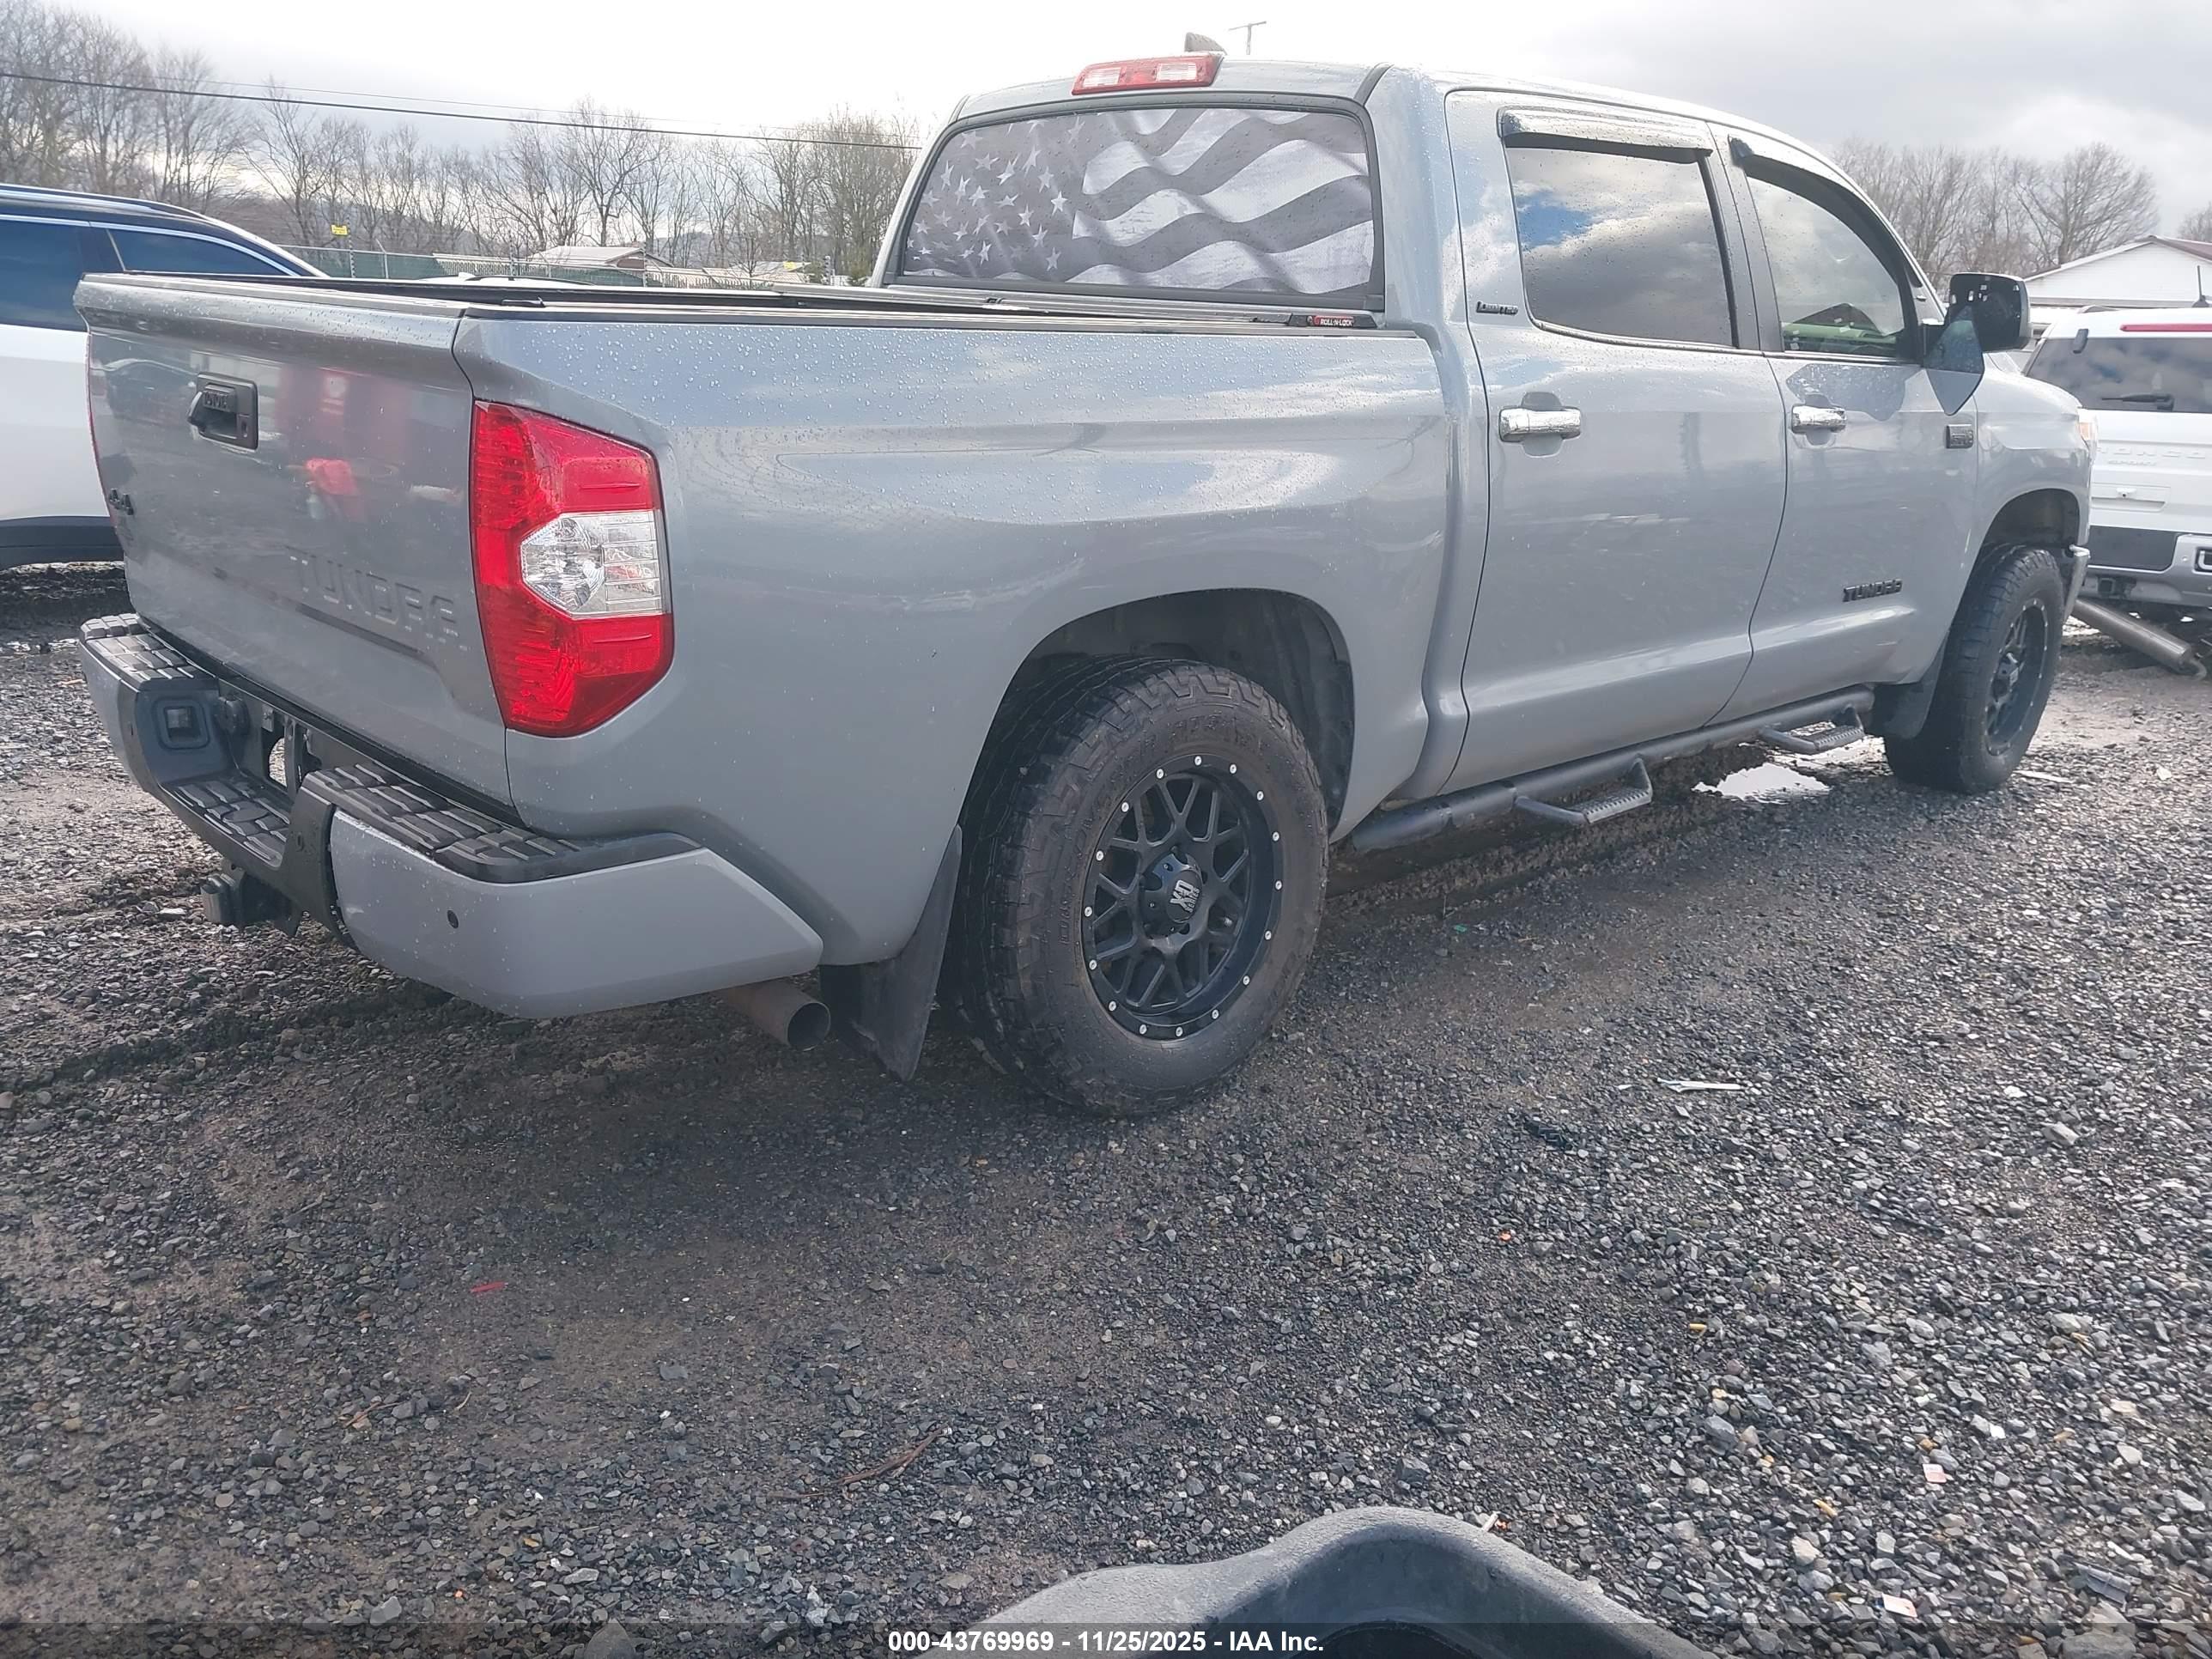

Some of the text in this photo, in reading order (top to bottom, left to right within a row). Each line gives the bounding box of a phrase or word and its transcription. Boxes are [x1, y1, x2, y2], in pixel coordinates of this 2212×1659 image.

[1320, 318, 1354, 327] ROLL-N-LOCK
[284, 544, 469, 652] TUNDRA
[1842, 578, 1903, 603] TUNDRA
[1170, 879, 1194, 910] XD
[1184, 887, 1200, 913] SERIES
